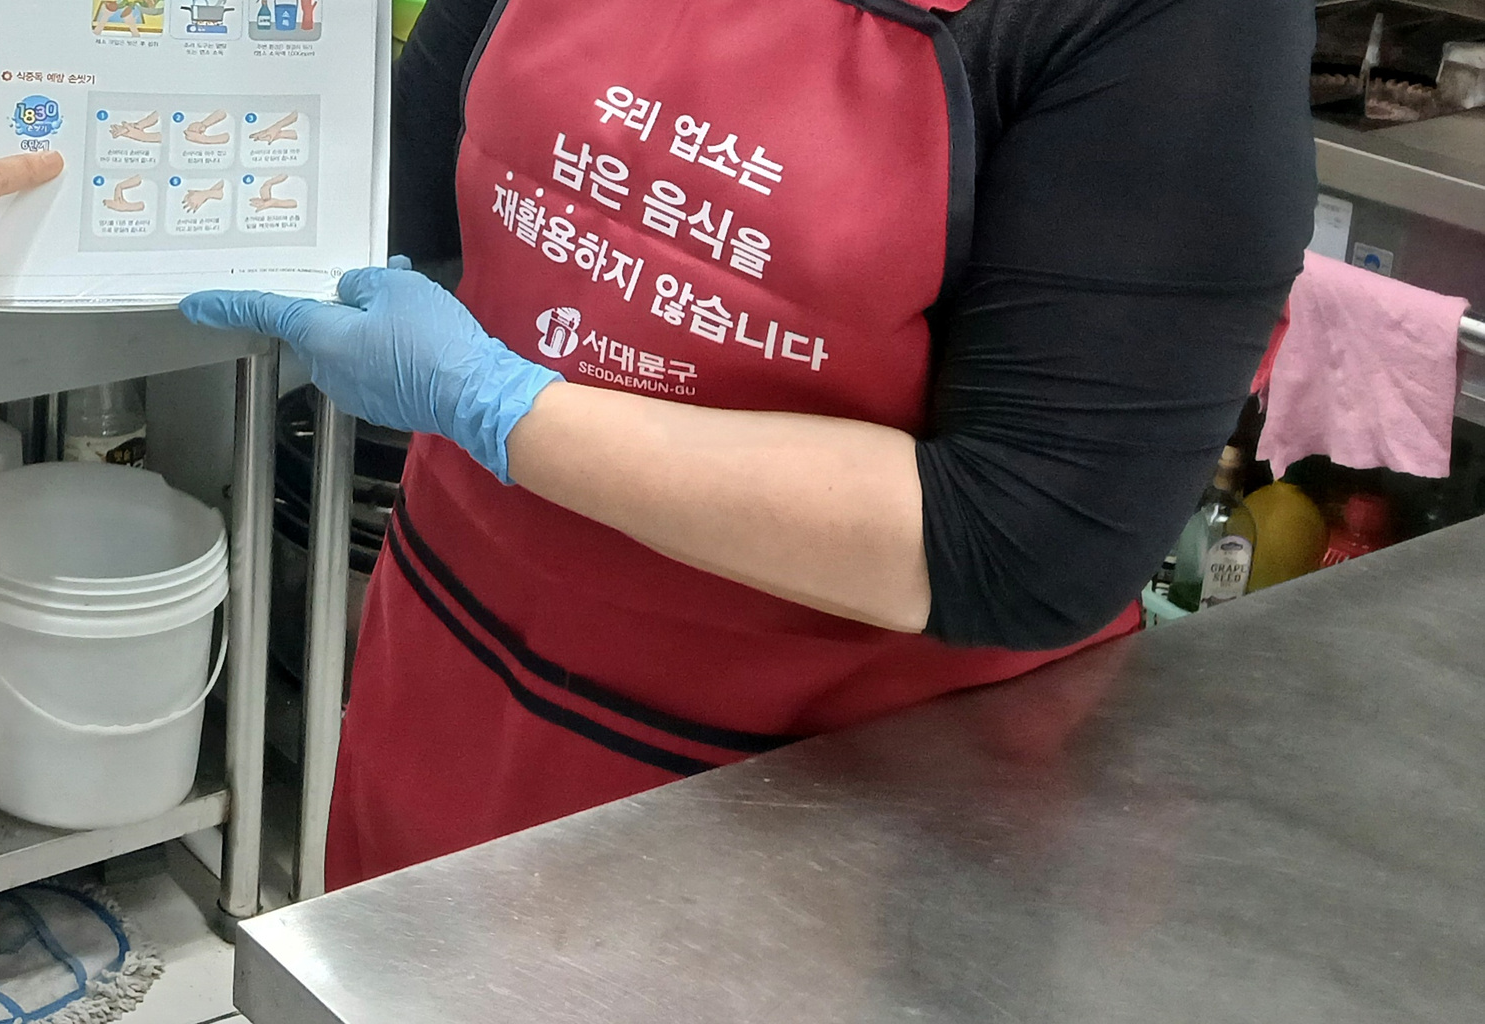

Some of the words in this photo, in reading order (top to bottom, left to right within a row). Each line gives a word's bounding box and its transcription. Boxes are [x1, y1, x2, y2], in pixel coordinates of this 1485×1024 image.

[16, 71, 44, 82] 식중독
[46, 72, 65, 84] 예방
[67, 74, 96, 85] 손씻기
[16, 100, 59, 125] 1830
[593, 85, 662, 141] 우리
[668, 114, 784, 196] 업소는
[551, 131, 631, 211] 남은
[641, 179, 772, 280] 음식을
[491, 181, 646, 302] 재활용하지
[650, 273, 830, 372] 않습니다
[577, 360, 697, 397] SEODAEMUN-GU
[580, 328, 699, 383] 서대문구
